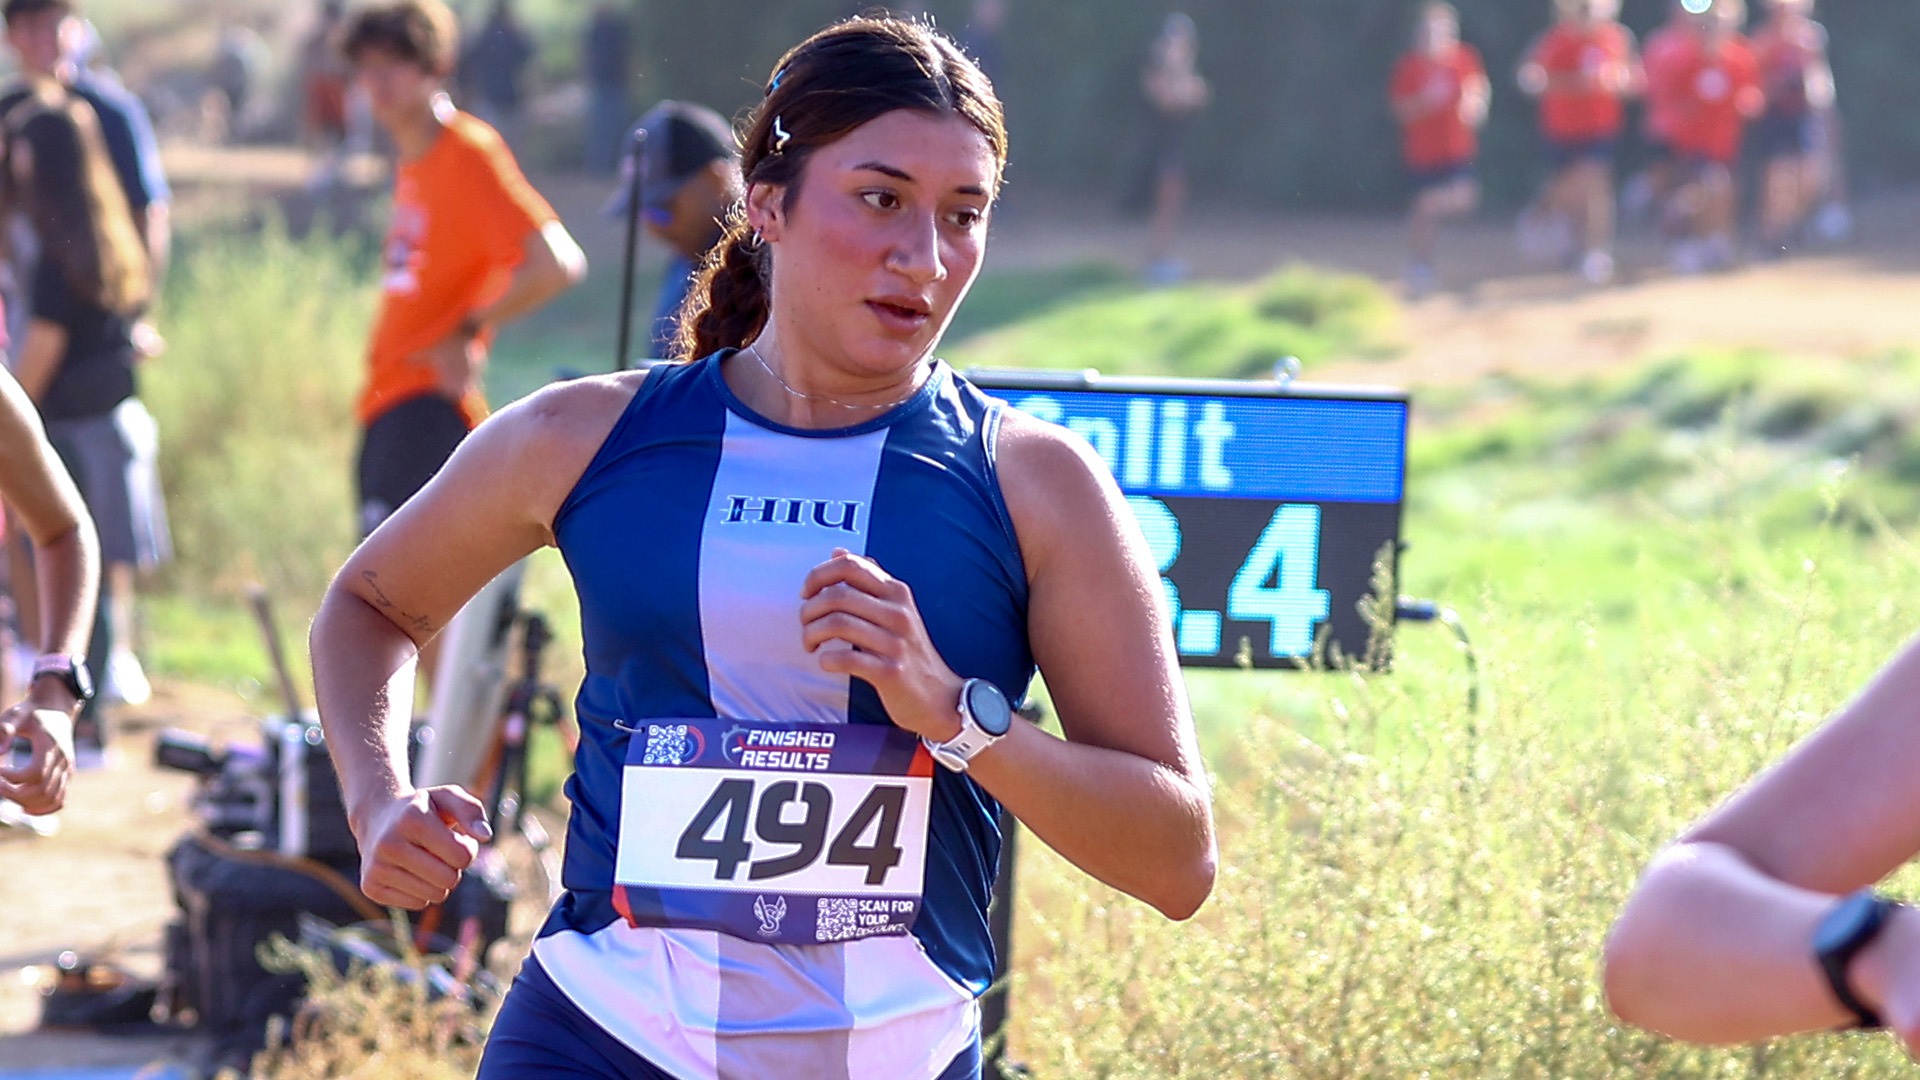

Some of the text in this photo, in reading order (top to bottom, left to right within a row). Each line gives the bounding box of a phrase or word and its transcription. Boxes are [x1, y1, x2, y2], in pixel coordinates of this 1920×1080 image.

[720, 495, 864, 534] HIU
[747, 730, 835, 747] FINISHED
[741, 751, 830, 769] RESULTS
[675, 778, 907, 885] 494
[859, 900, 914, 912] SCAN FOR
[859, 914, 889, 925] YOUR
